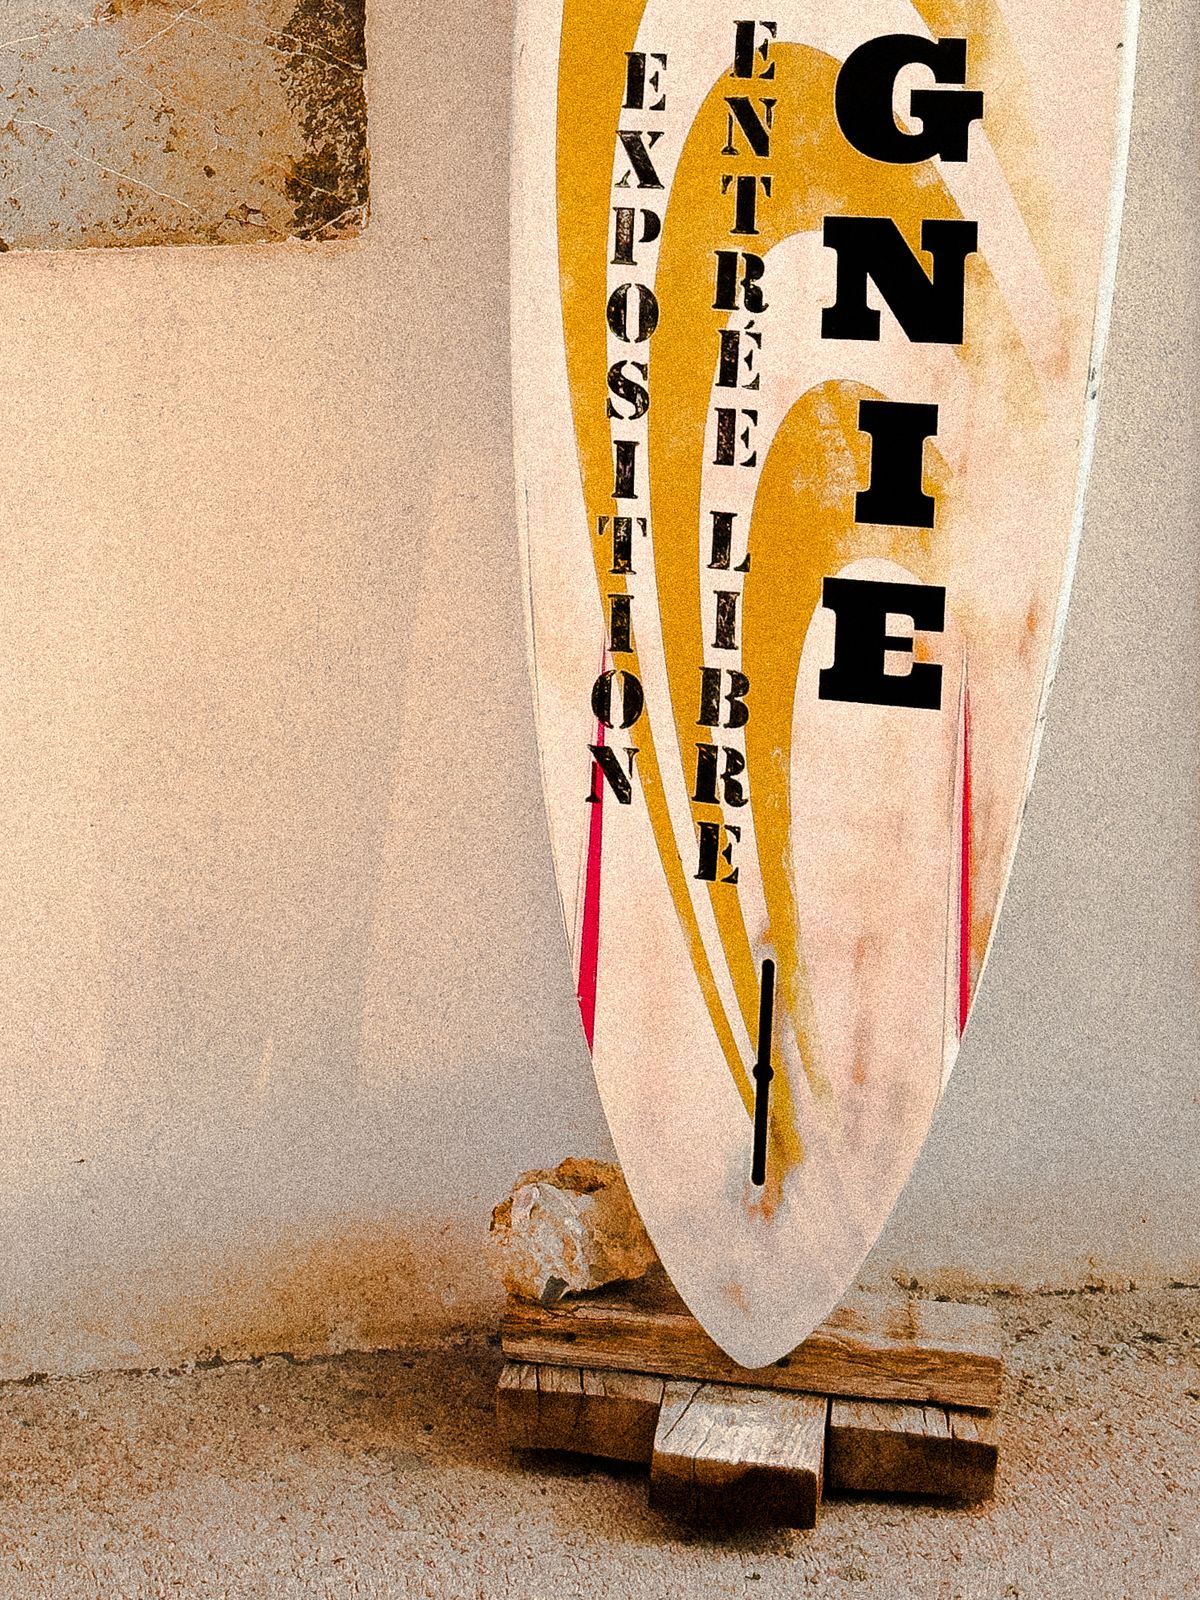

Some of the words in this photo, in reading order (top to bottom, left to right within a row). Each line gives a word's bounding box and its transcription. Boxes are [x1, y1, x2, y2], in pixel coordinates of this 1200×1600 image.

[585, 51, 668, 805] EXPOSITION
[710, 19, 778, 468] ENTRÉE
[693, 510, 751, 884] LIBRE
